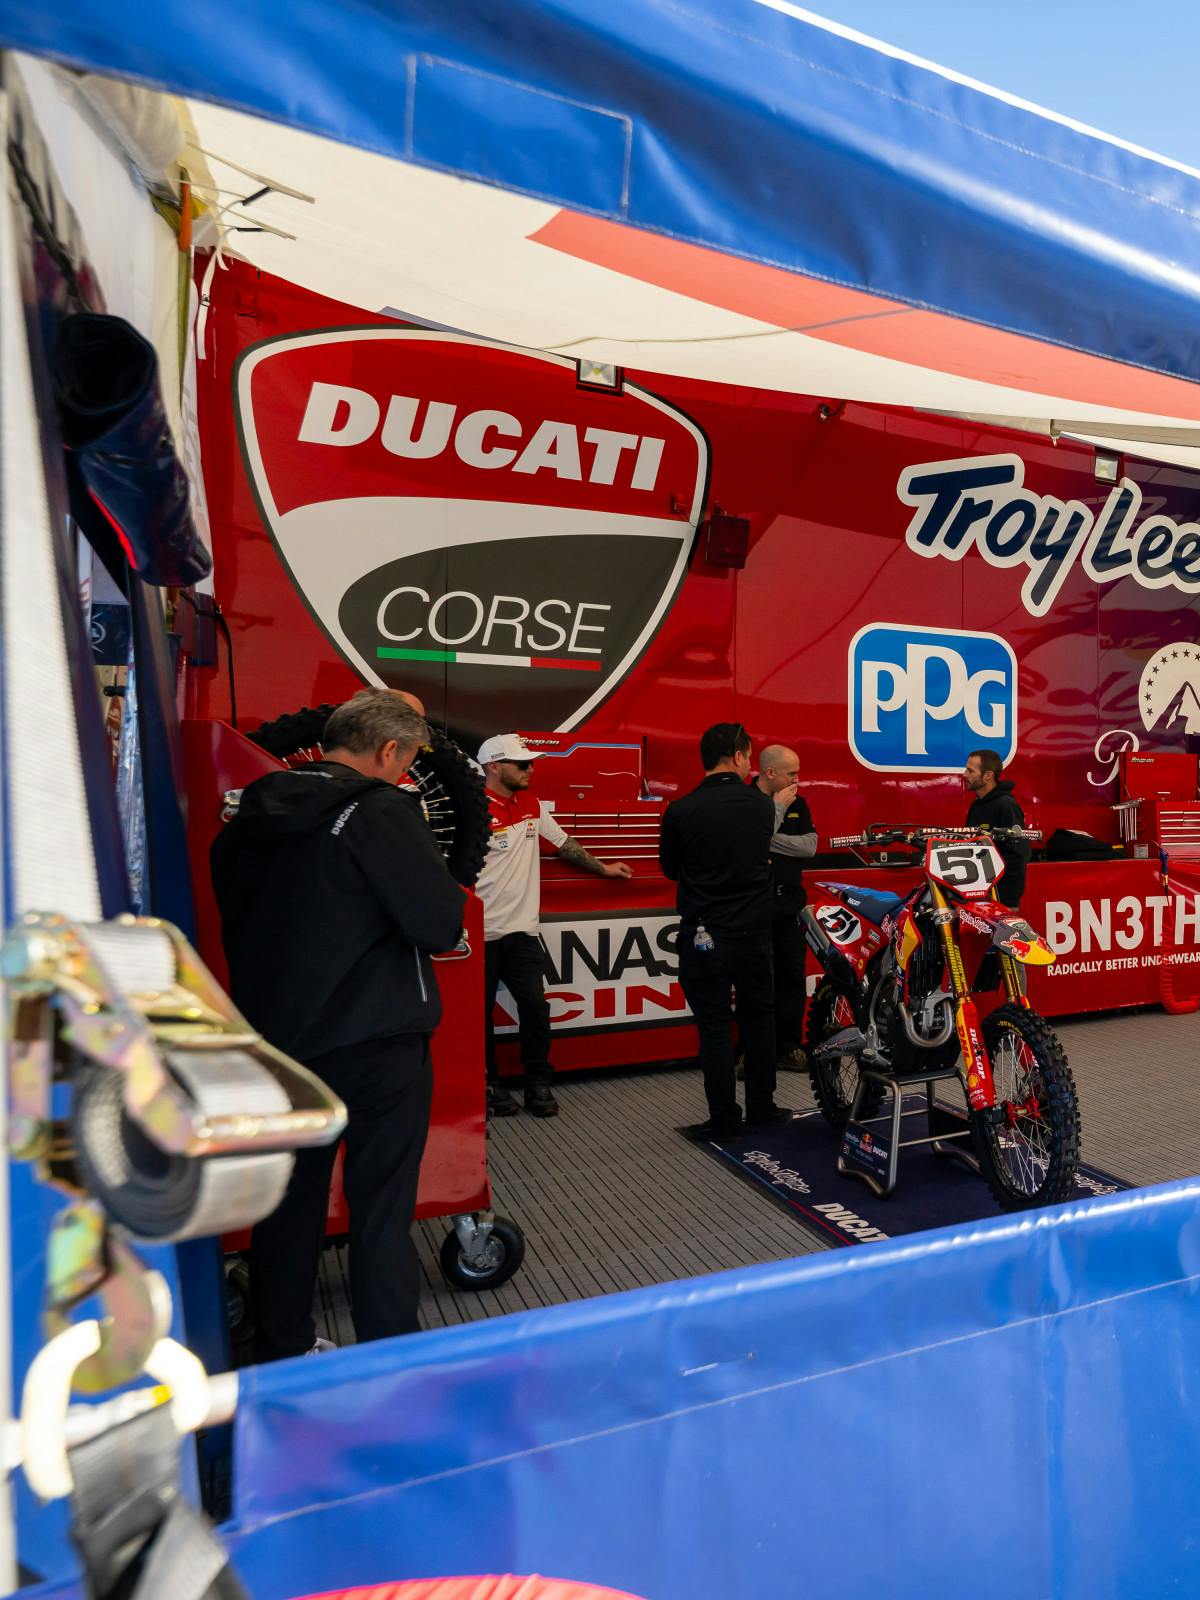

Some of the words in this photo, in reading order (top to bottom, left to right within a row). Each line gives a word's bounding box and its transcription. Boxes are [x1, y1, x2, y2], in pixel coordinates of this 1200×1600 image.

[298, 382, 666, 491] DUCATI
[897, 453, 1094, 617] Troy
[376, 586, 611, 654] CORSE
[861, 643, 1006, 755] PPG
[937, 848, 996, 886] 51
[819, 907, 860, 943] 51
[1047, 960, 1103, 976] RADICALLY
[1106, 956, 1138, 971] BETTER
[811, 1202, 891, 1242] DUCAT
